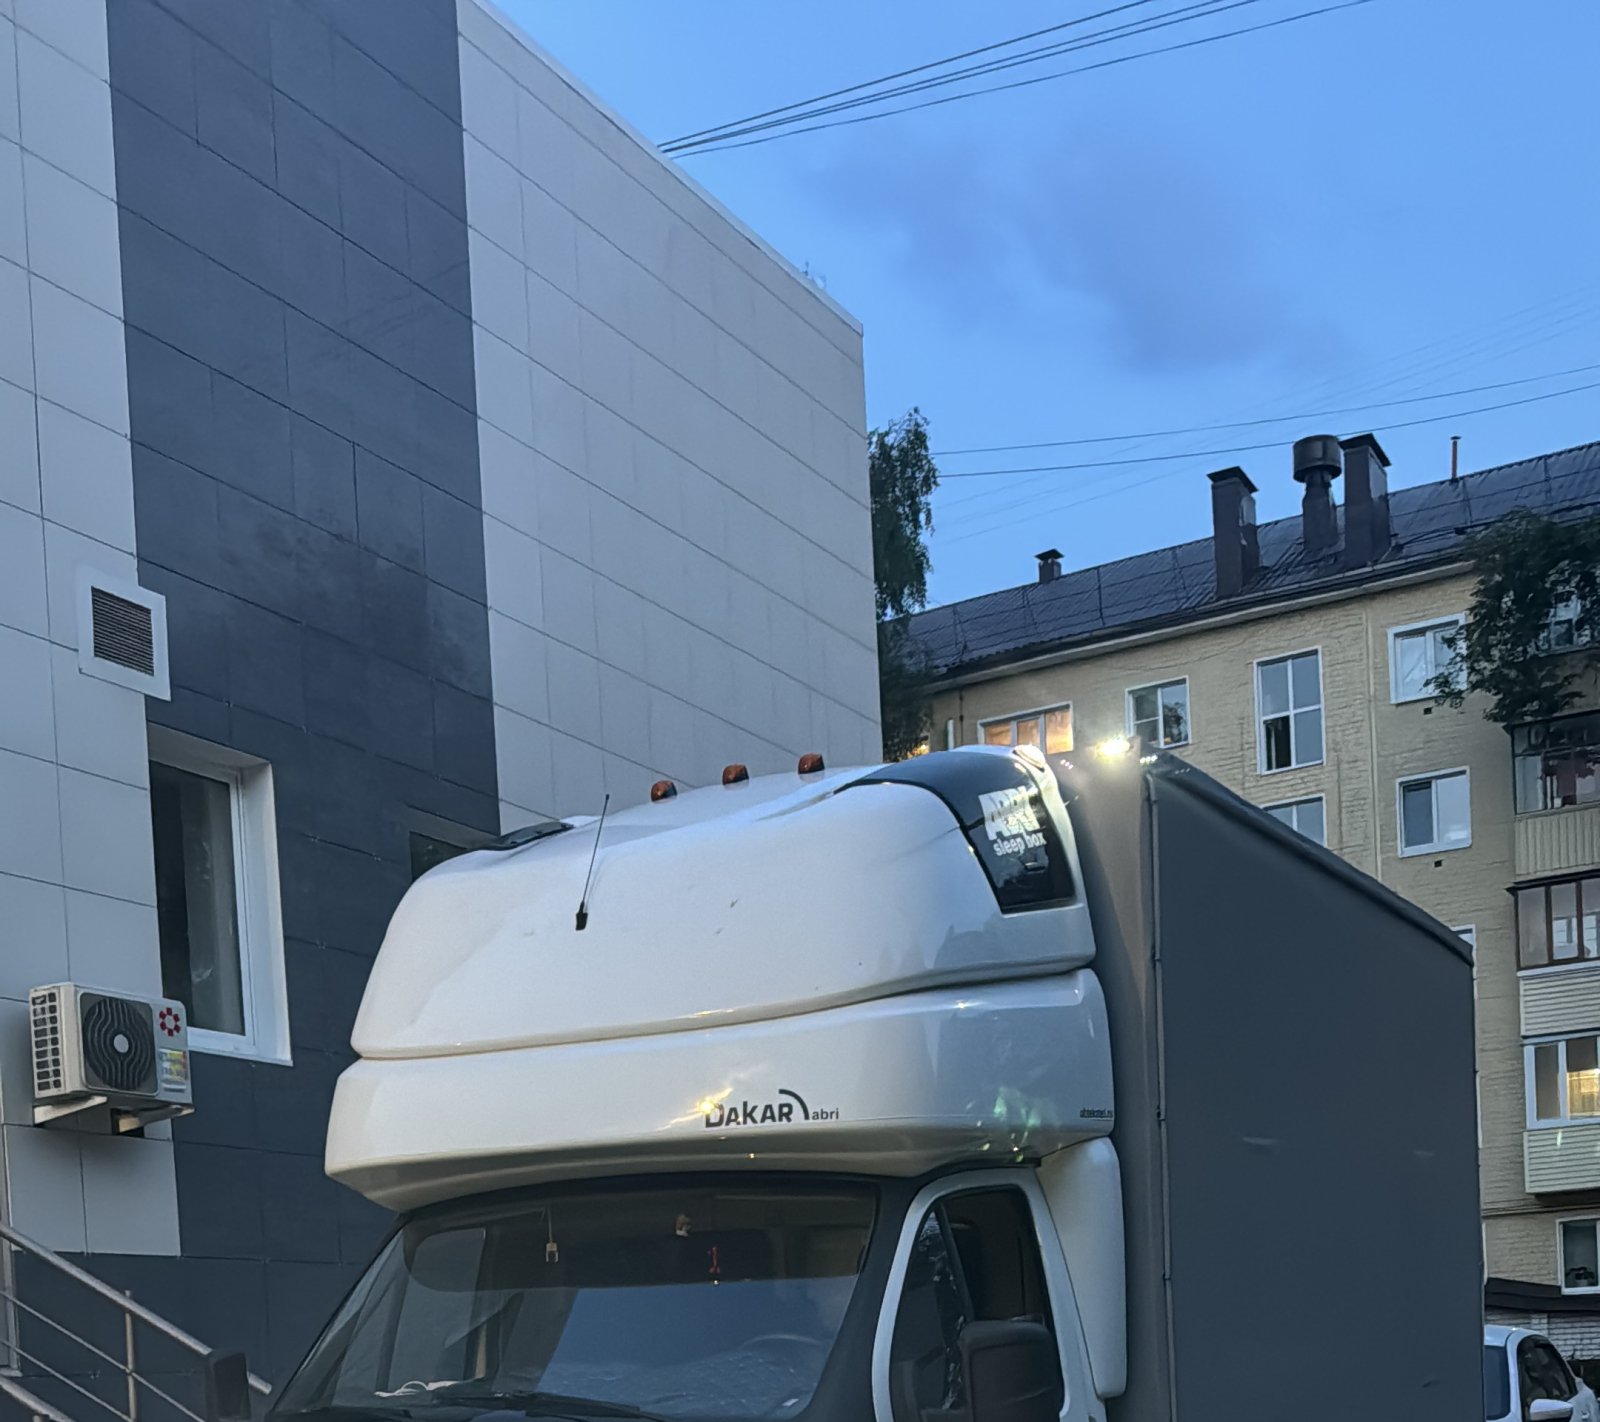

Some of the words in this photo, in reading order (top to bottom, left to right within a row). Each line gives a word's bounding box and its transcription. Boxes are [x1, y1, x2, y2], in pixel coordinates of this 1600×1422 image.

[993, 836, 1026, 857] sleep
[1022, 829, 1048, 849] box
[704, 1100, 793, 1128] DAKAR
[811, 1107, 840, 1121] abri
